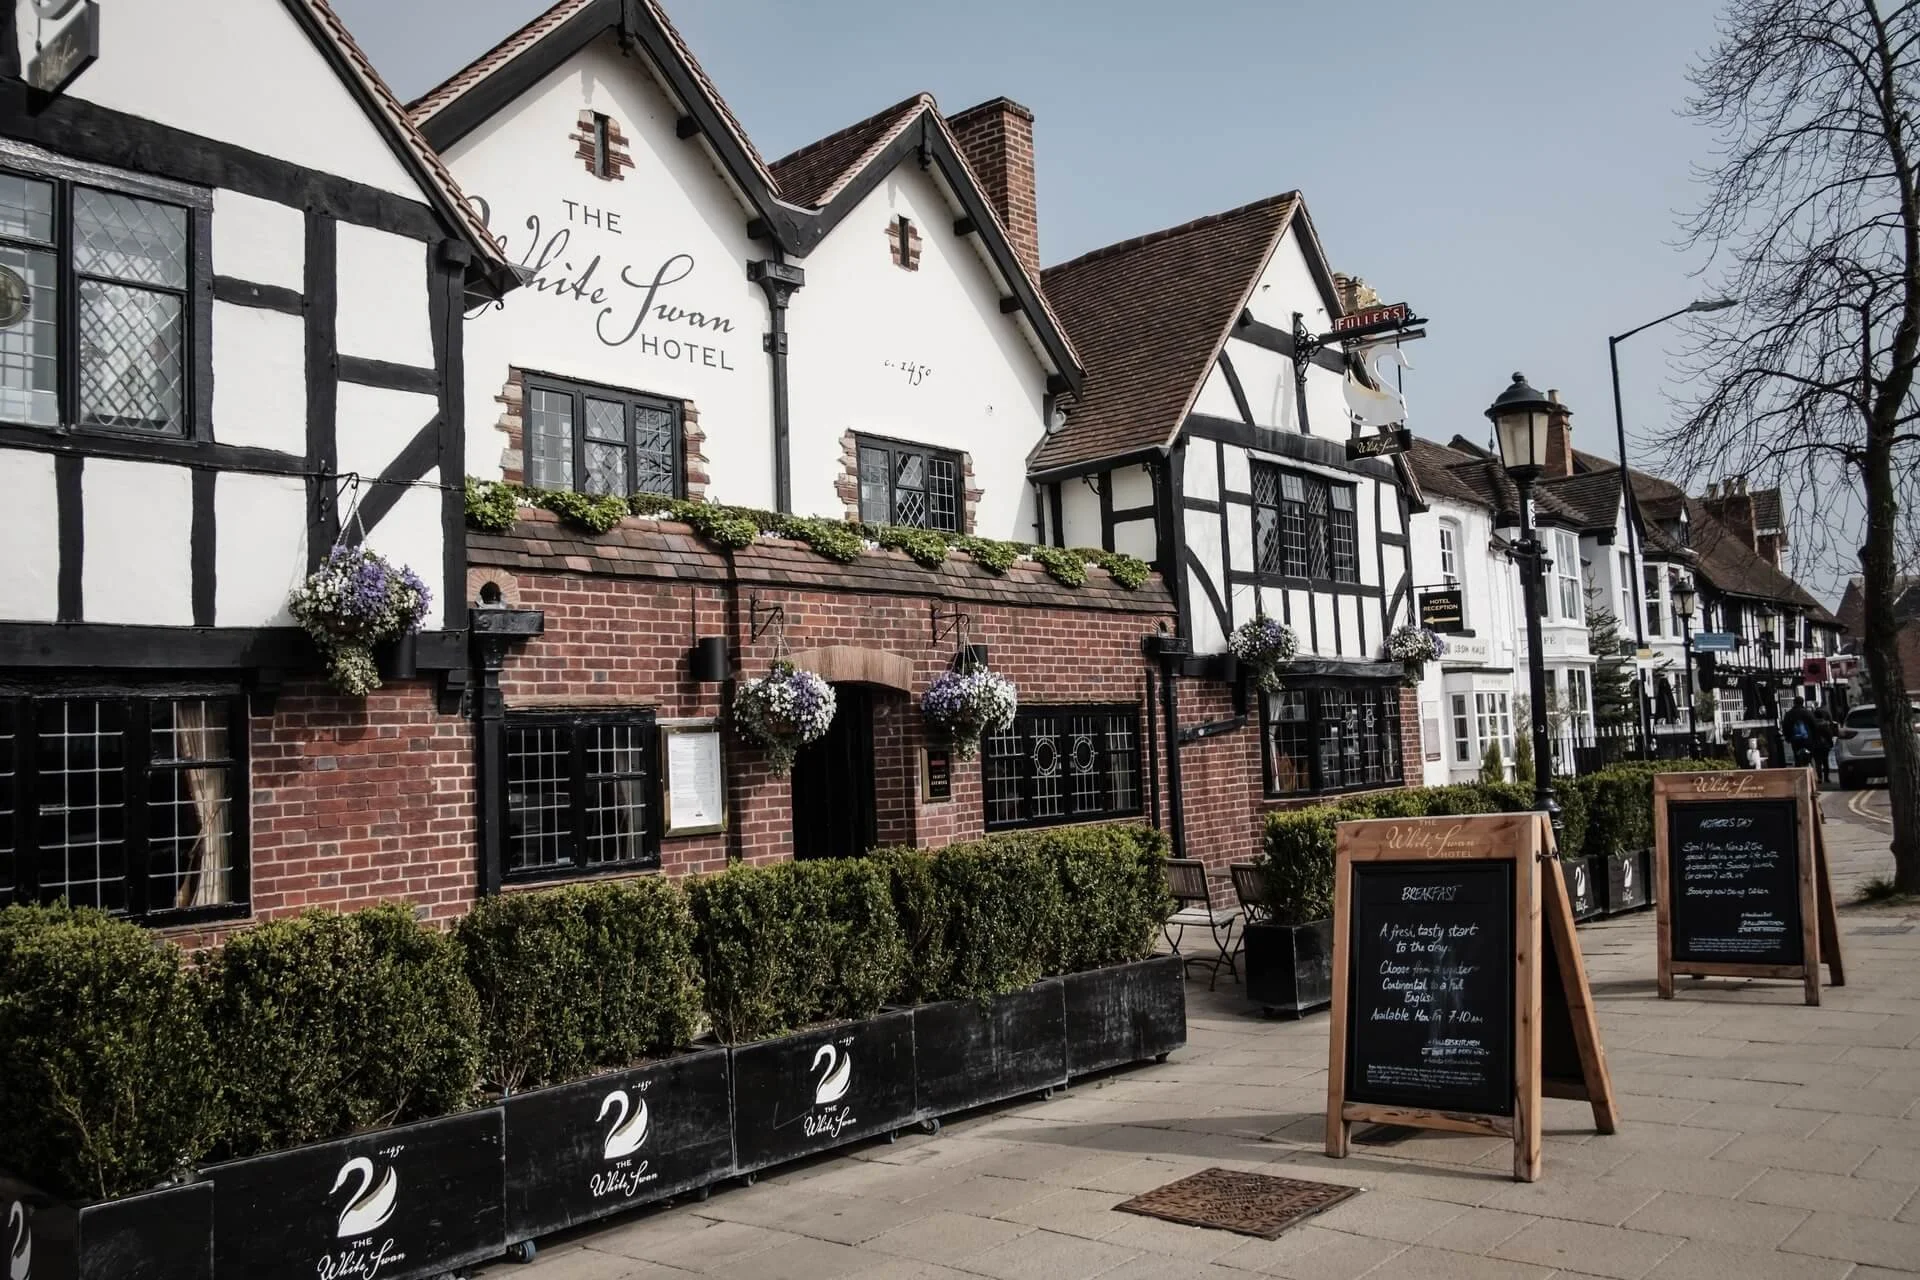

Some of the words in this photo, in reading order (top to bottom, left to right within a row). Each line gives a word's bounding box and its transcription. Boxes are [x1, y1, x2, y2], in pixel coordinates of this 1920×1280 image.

[562, 199, 622, 234] THE
[596, 254, 734, 346] Swan
[641, 333, 734, 371] HOTEL
[900, 361, 931, 386] 1450
[1440, 850, 1472, 858] HOTEL
[1401, 886, 1463, 901] BREAKFAST
[1380, 923, 1388, 937] A
[1418, 923, 1444, 946] tasty
[1448, 923, 1479, 937] start
[1396, 941, 1407, 953] to
[1410, 941, 1425, 952] the
[1380, 960, 1410, 974] Choose
[1440, 982, 1447, 990] a
[1370, 1008, 1410, 1021] Available
[824, 1104, 837, 1113] THE
[804, 1114, 833, 1137] White
[616, 1159, 632, 1169] THE
[590, 1170, 627, 1197] White
[625, 1160, 658, 1197] Swan
[352, 1237, 373, 1248] THE
[317, 1250, 366, 1280] White
[362, 1238, 406, 1280] Swan
